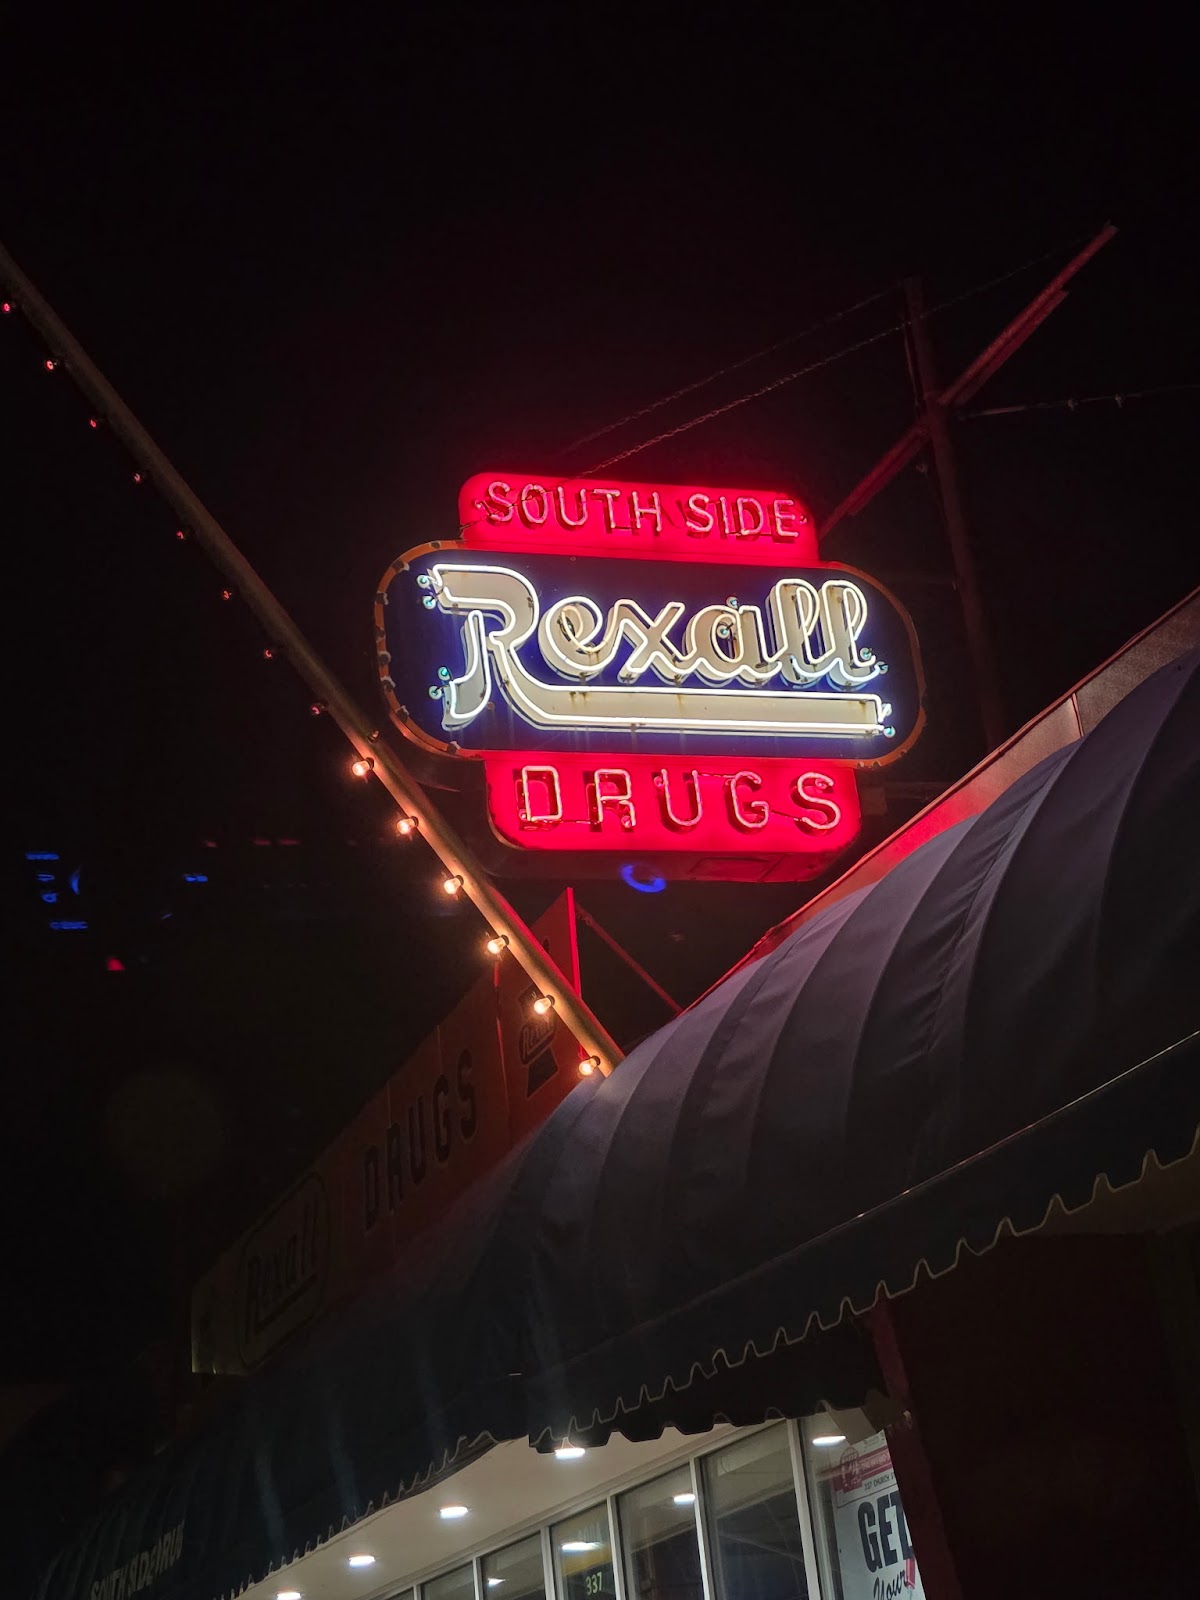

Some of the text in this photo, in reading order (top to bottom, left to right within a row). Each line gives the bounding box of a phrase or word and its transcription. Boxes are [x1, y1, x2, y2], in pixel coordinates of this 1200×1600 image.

[486, 481, 799, 538] SOUTH SIDE
[430, 563, 886, 734] Rexall
[519, 765, 841, 831] DRUGS
[364, 1049, 477, 1230] DRUGS
[857, 1490, 914, 1573] GET
[585, 1571, 603, 1596] 337
